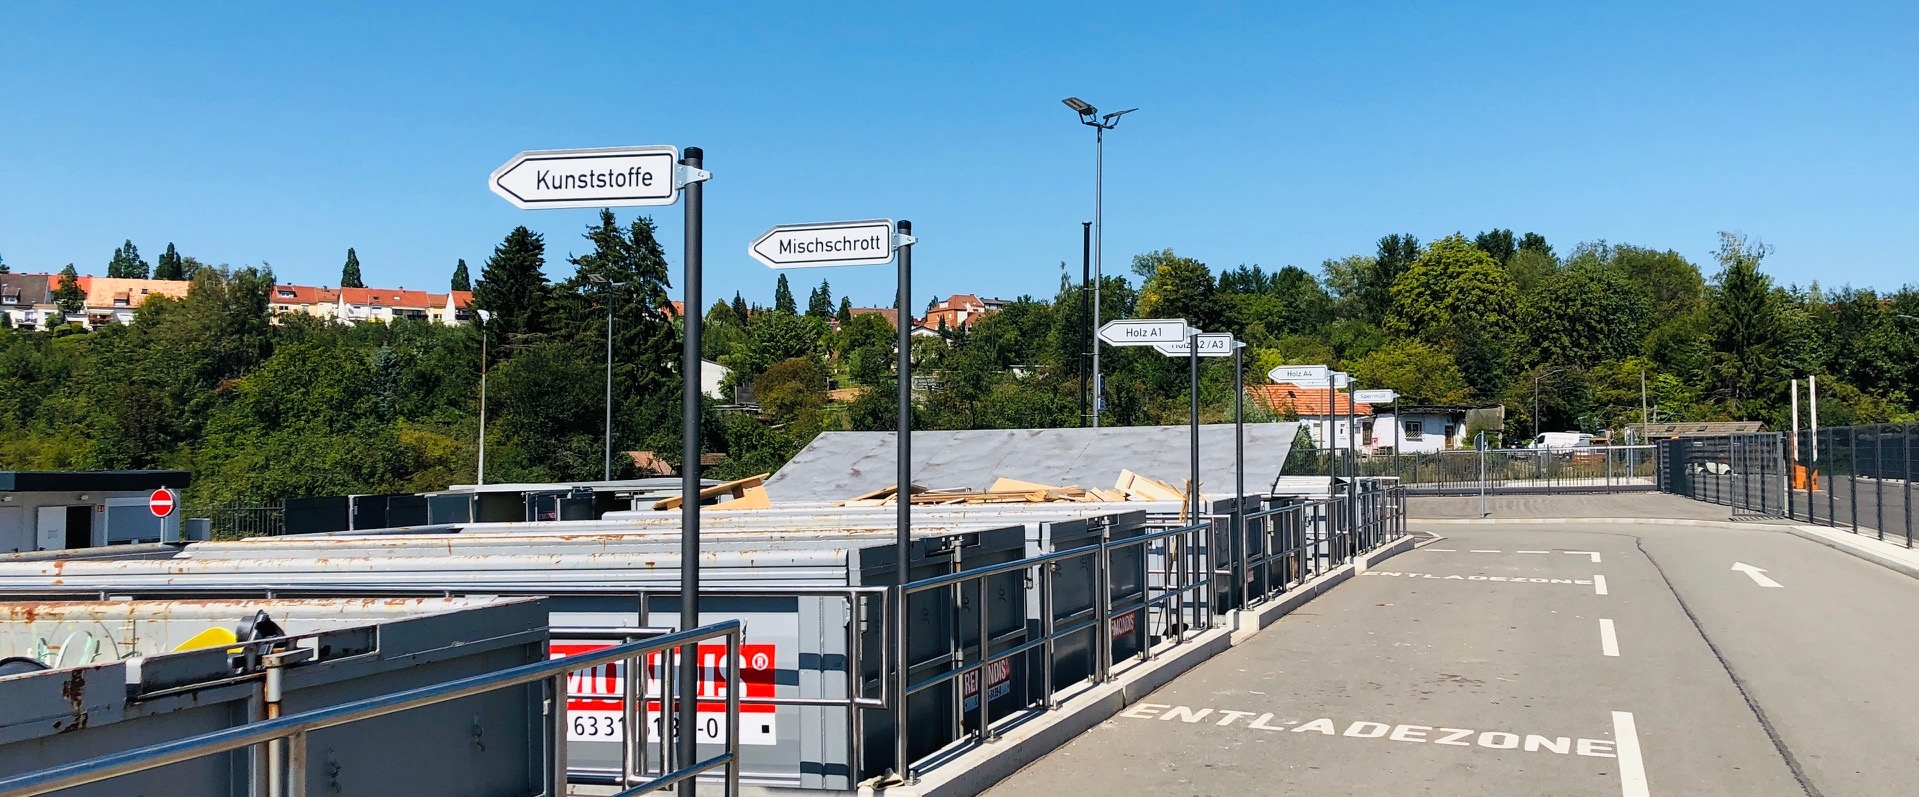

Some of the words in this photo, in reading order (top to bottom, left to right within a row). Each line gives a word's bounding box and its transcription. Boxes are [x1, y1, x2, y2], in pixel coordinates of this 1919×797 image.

[536, 165, 653, 190] Kunststoffe
[778, 234, 881, 255] Mischschrott
[1126, 328, 1147, 337] Holz
[1150, 328, 1162, 337] A1
[1212, 340, 1224, 349] A3
[1362, 571, 1594, 585] ENTLADEZONE
[964, 659, 1006, 695] RENDIS
[1121, 703, 1617, 758] ENTLADEZONE
